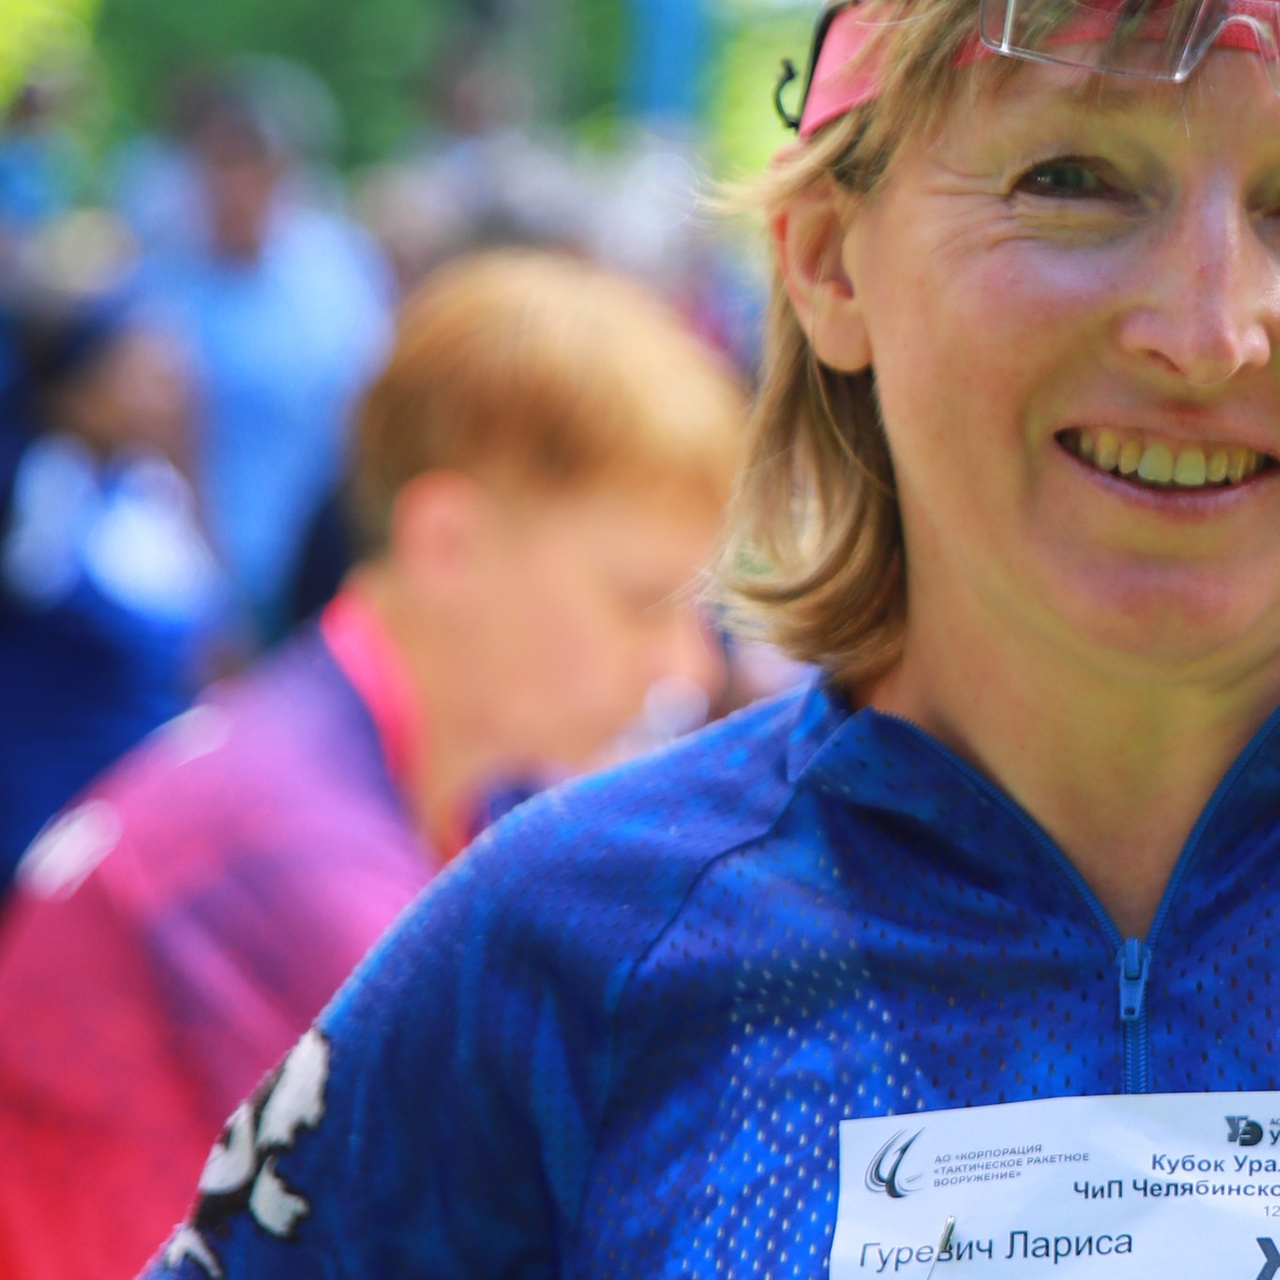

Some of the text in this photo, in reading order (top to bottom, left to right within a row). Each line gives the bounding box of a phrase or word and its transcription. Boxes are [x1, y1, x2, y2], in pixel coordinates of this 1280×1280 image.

[934, 1144, 1042, 1164] АО «КОРПОРАЦИЯ
[934, 1152, 1090, 1174] «ТАКТИЧЕСКОЕ РАКЕТНОЕ
[1151, 1153, 1226, 1175] Кубок
[933, 1170, 1022, 1187] ВООРУЖЕНИЕ»
[1073, 1179, 1123, 1199] ЧиП
[1263, 1206, 1280, 1217] 12
[859, 1230, 1133, 1273] Гуревич Лариса
